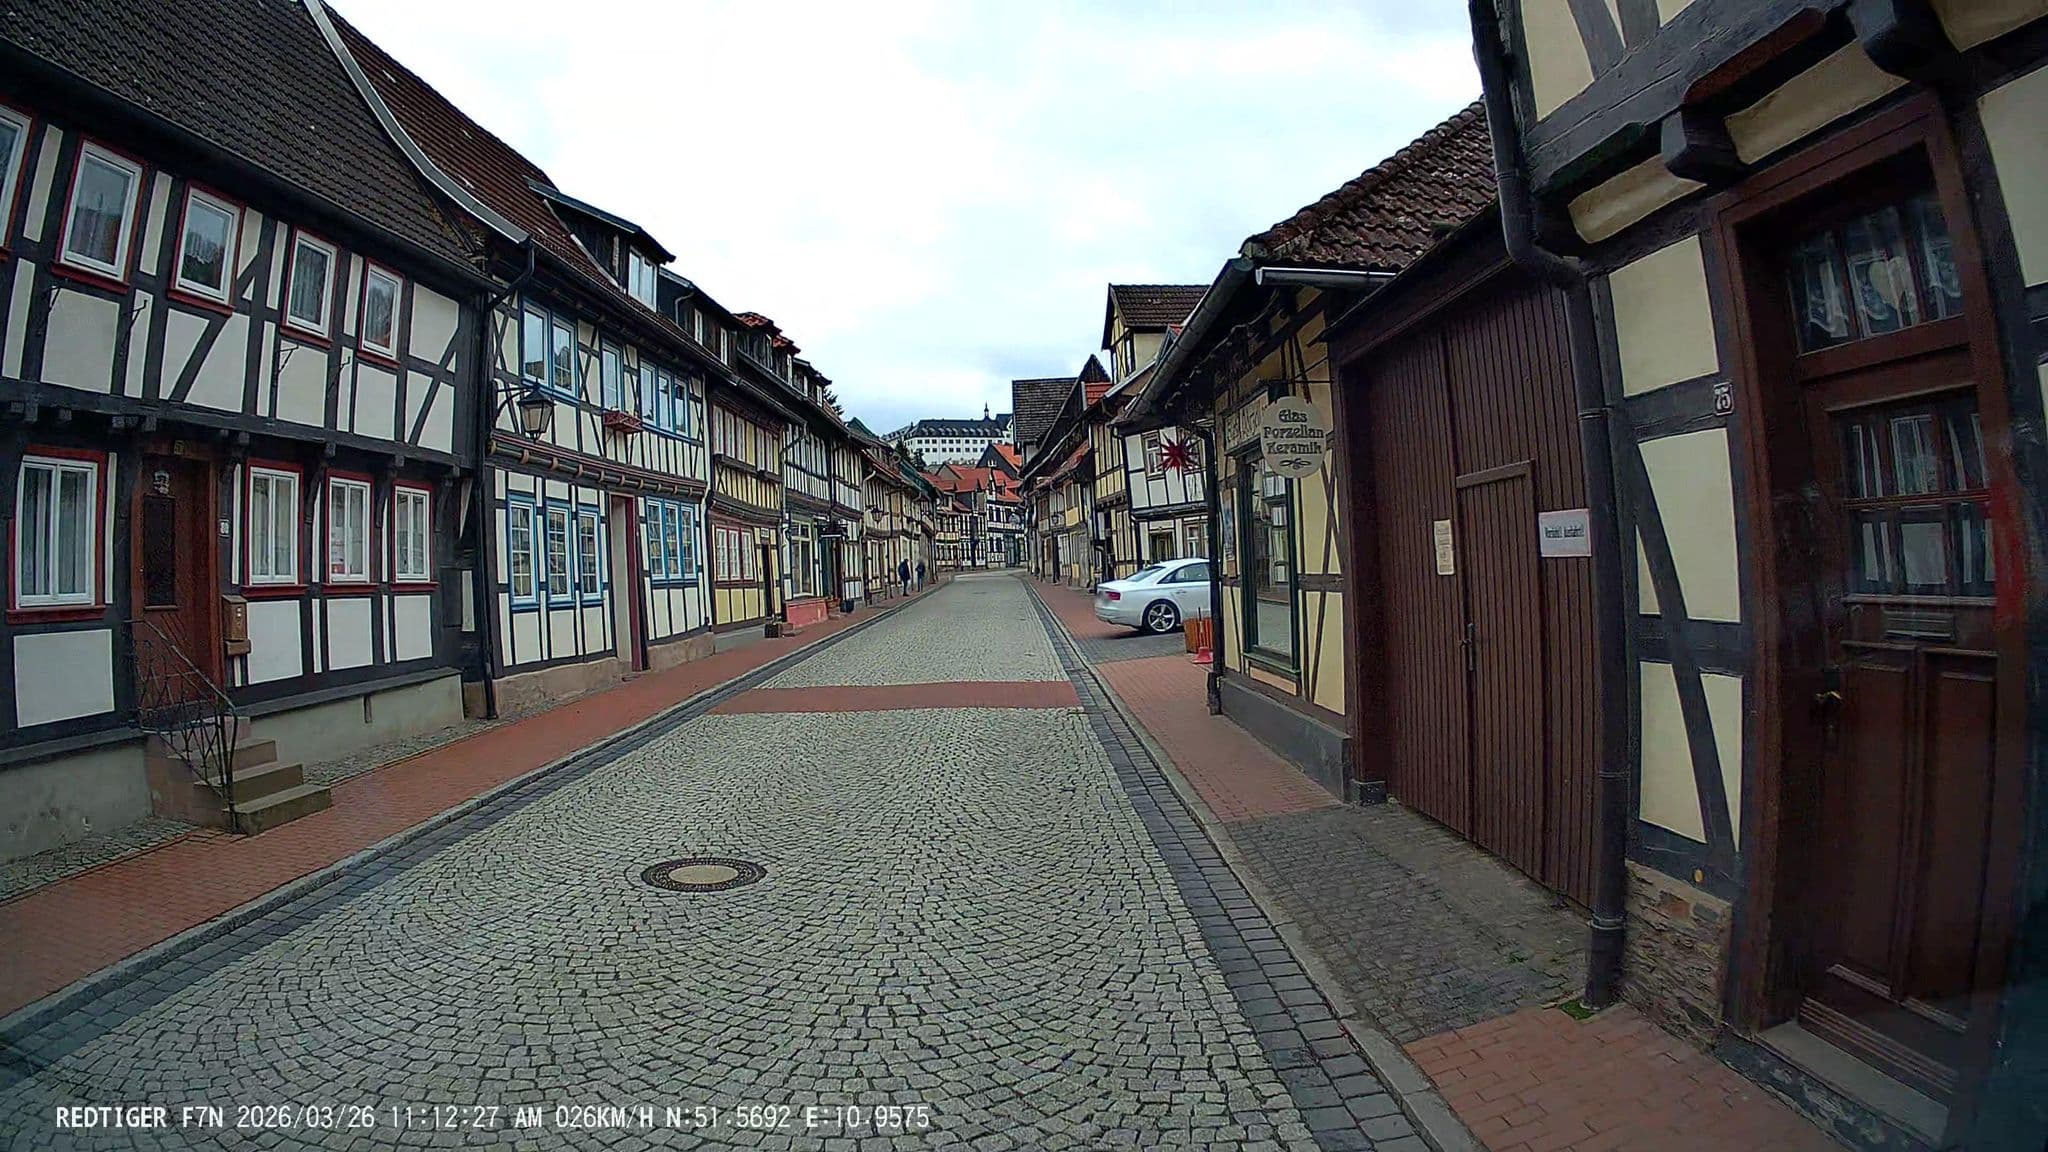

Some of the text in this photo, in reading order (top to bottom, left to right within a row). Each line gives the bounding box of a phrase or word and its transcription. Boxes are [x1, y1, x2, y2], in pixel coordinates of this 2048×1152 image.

[1279, 409, 1308, 423] Glas
[1263, 424, 1324, 439] Porzellan
[1266, 441, 1323, 454] Keramik
